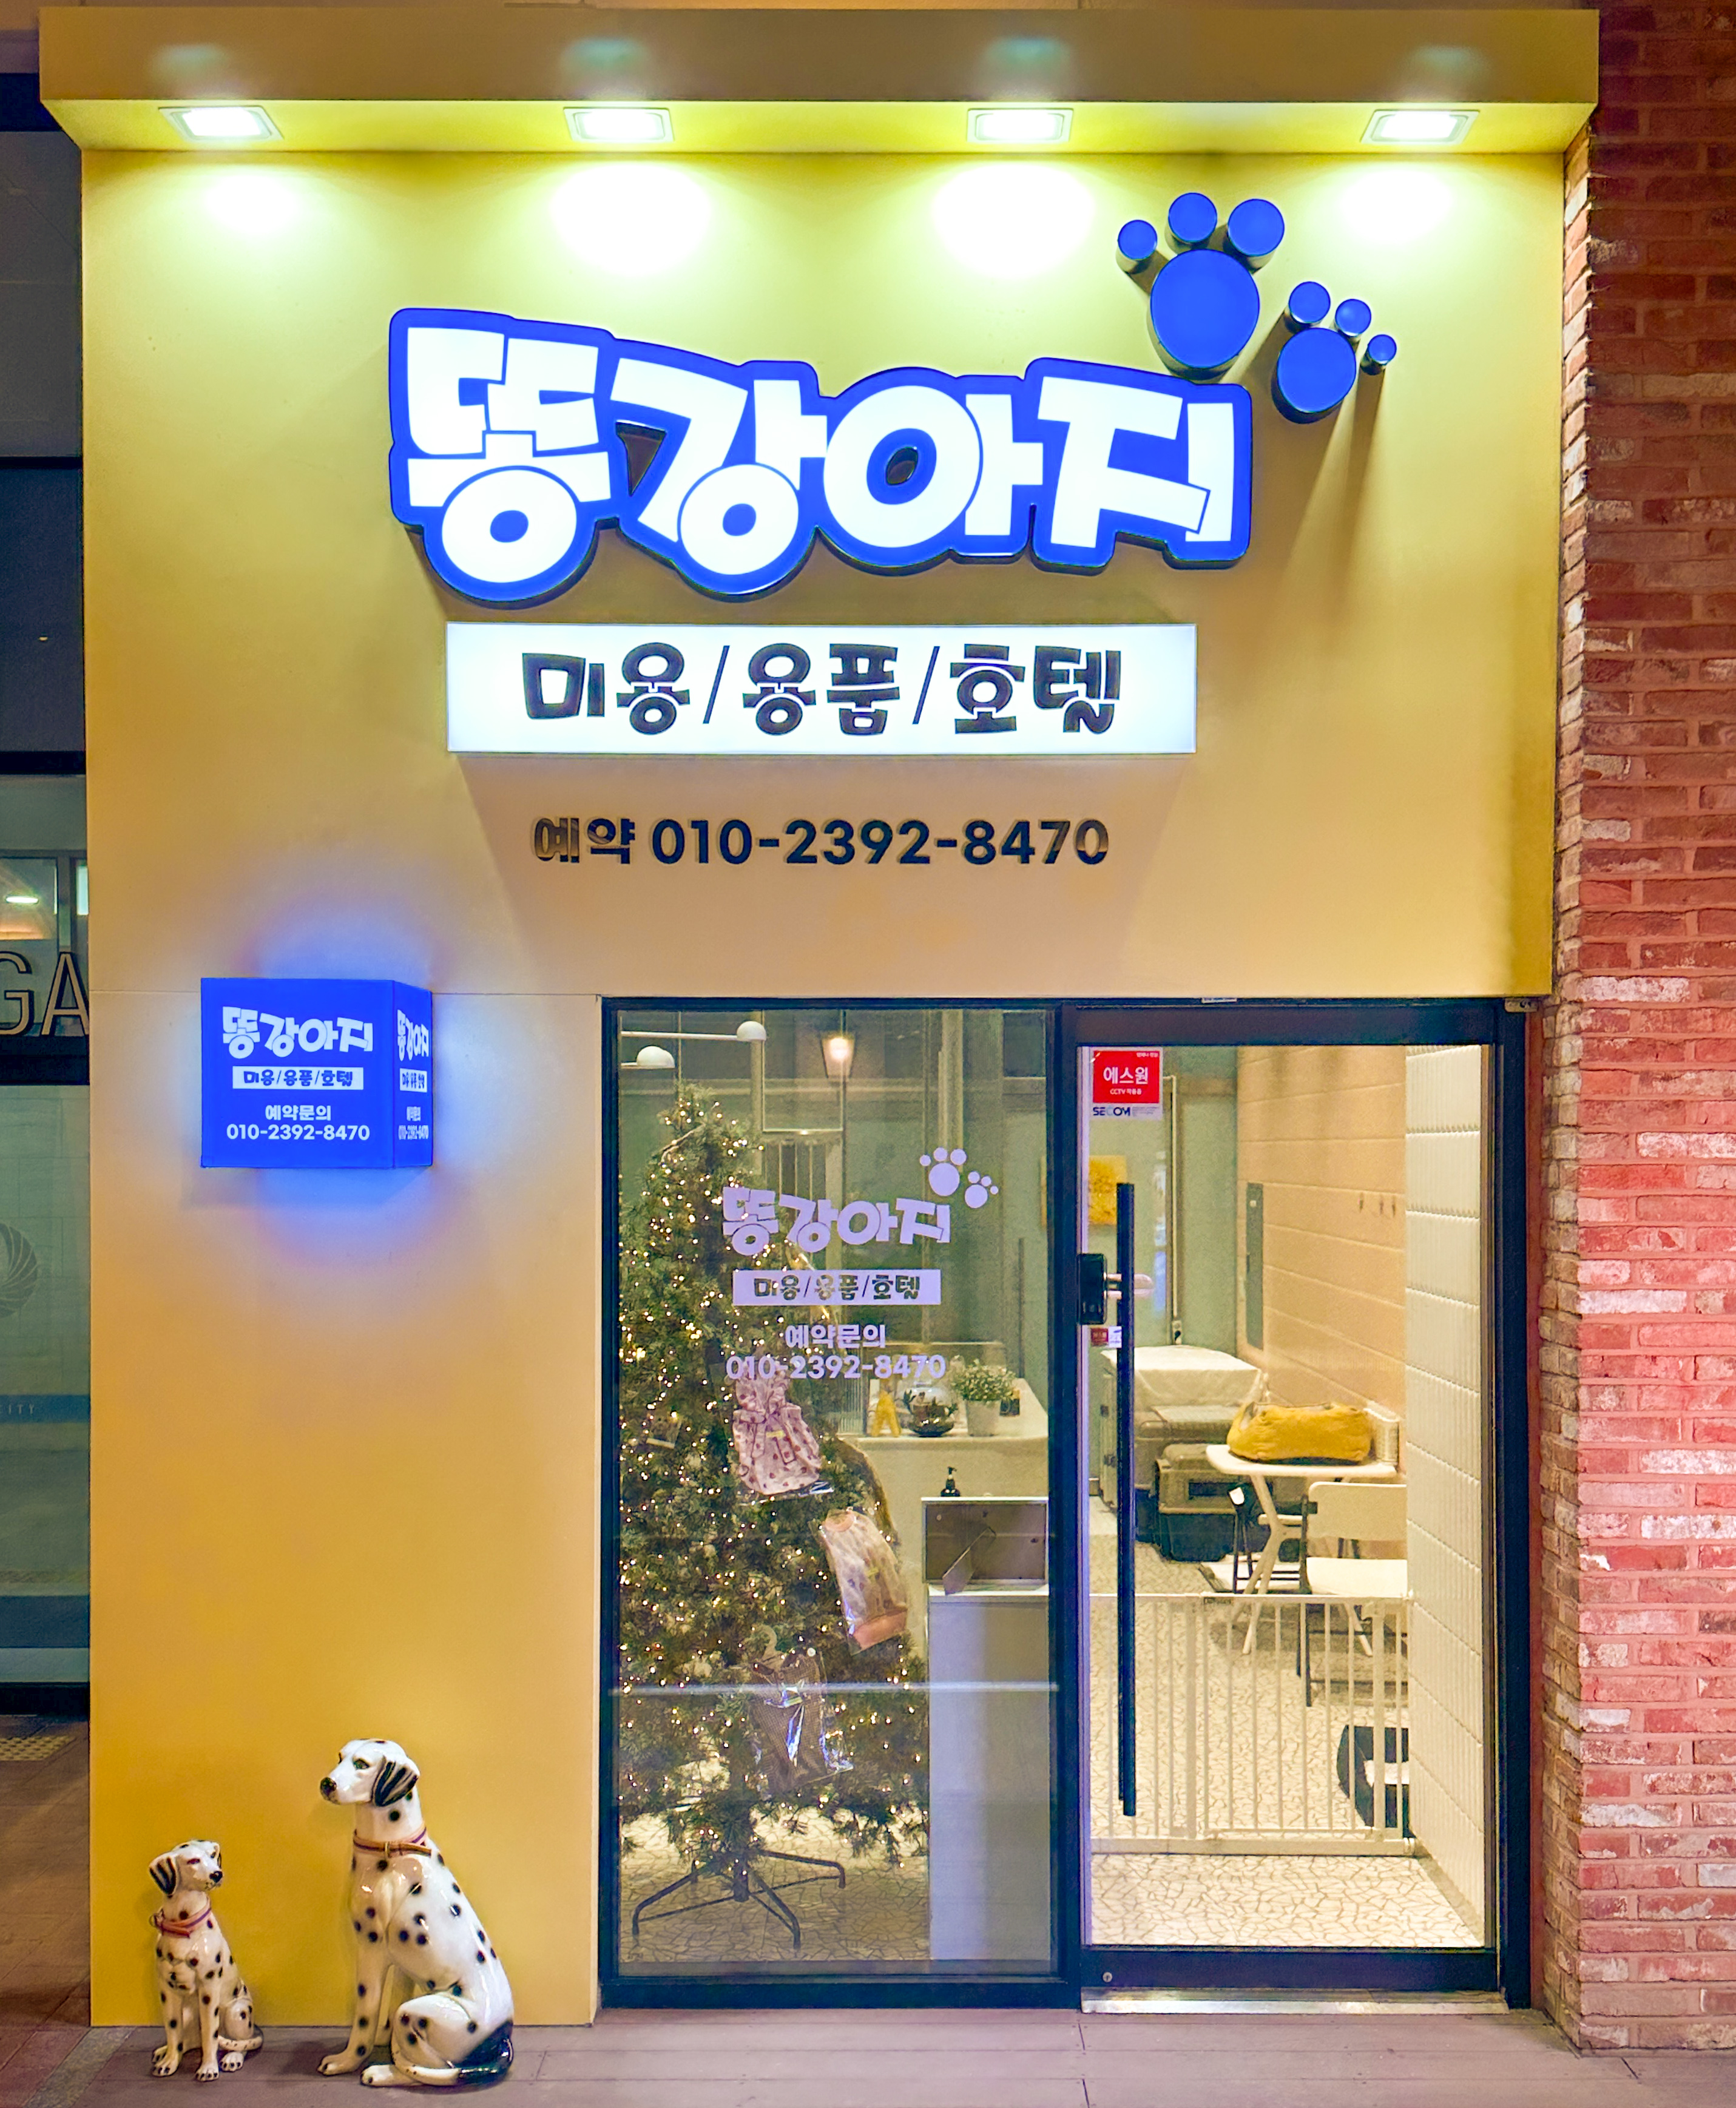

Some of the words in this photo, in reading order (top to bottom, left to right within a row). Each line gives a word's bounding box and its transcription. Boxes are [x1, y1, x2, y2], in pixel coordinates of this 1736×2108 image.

[408, 325, 1234, 584] 똥강아지
[521, 642, 1121, 736] 미용/용품/호텔
[534, 816, 636, 867] 예약
[651, 818, 1110, 867] 010-2392-8470
[223, 1006, 373, 1059] 똥강아지
[243, 1070, 353, 1086] 미용/용품/호텔
[1103, 1067, 1148, 1084] 에스원
[265, 1105, 331, 1121] 예약문의
[226, 1124, 370, 1140] 010-2392-8470
[723, 1187, 951, 1255] 똥강아지
[754, 1275, 920, 1300] 미용/용품/호텔
[785, 1324, 886, 1348] 예약문의
[726, 1354, 945, 1379] 010-2392-8470
[0, 1404, 35, 1414] ITY
